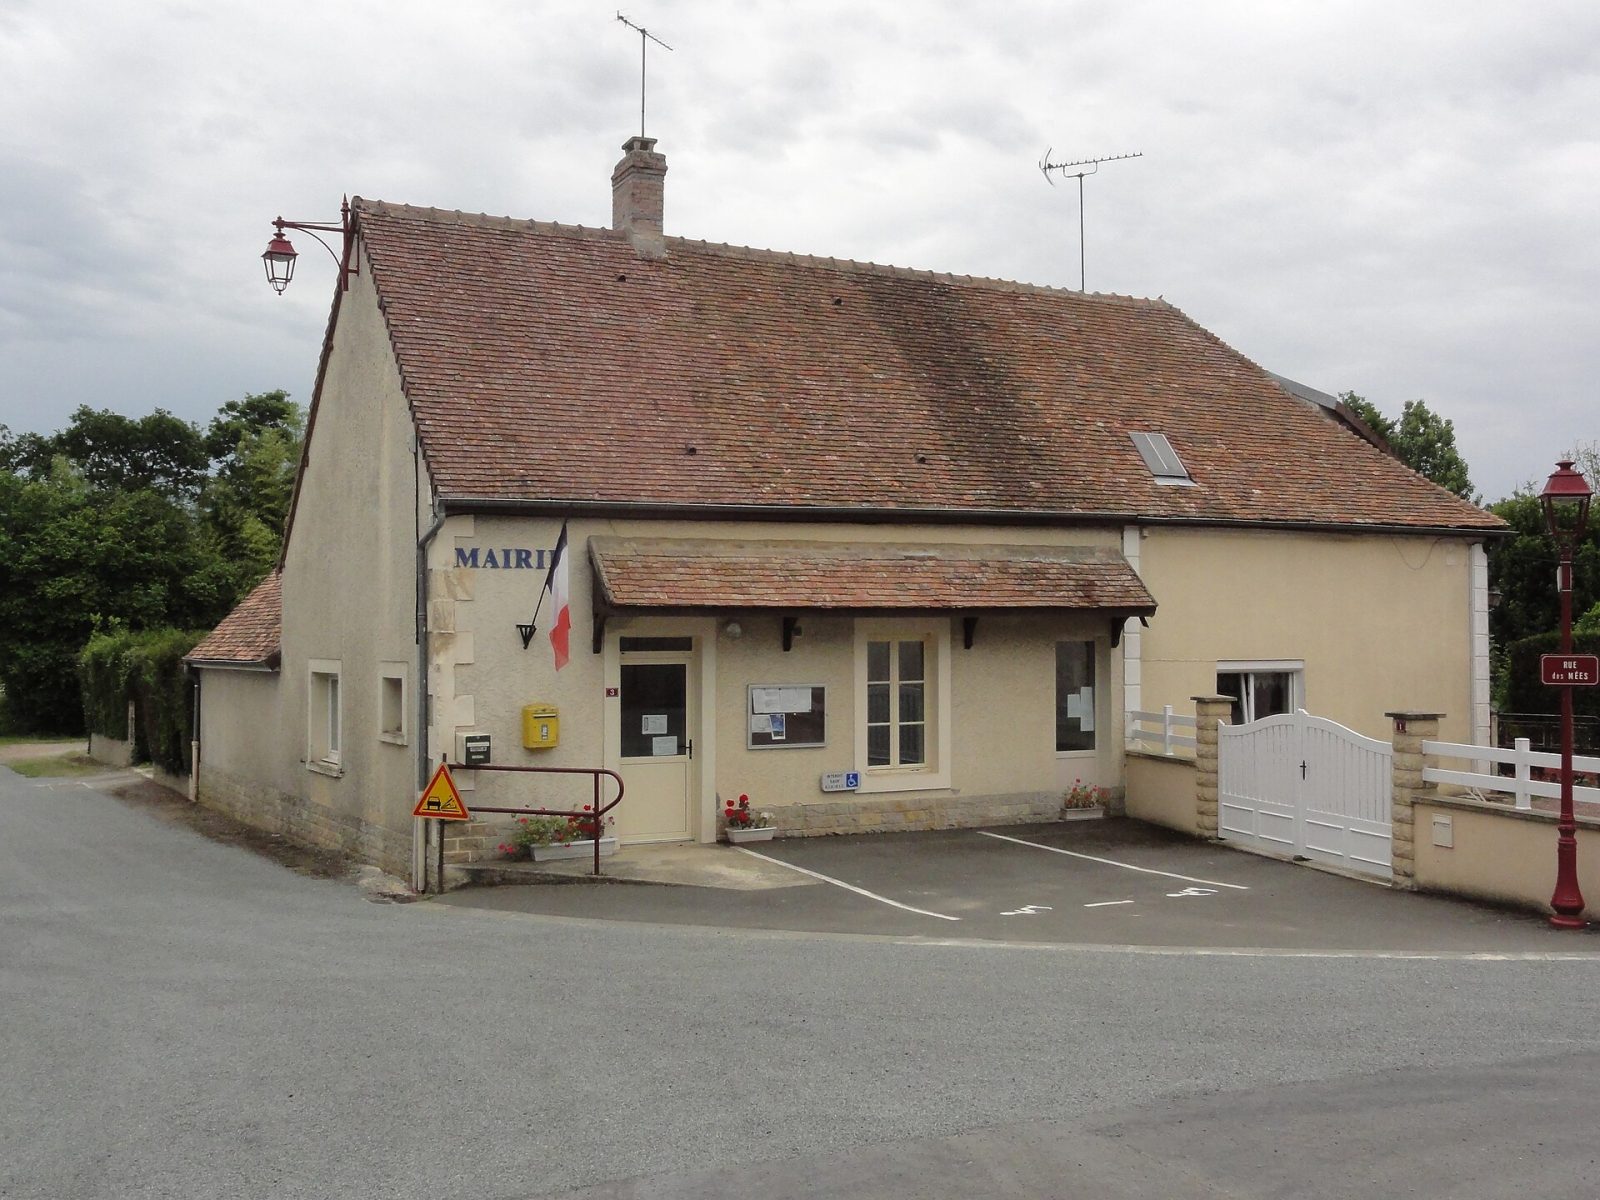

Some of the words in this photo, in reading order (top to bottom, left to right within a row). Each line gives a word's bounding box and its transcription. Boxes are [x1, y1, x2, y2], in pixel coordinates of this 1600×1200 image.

[1563, 661, 1577, 669] RUE
[1552, 672, 1564, 680] des
[609, 688, 615, 696] 3
